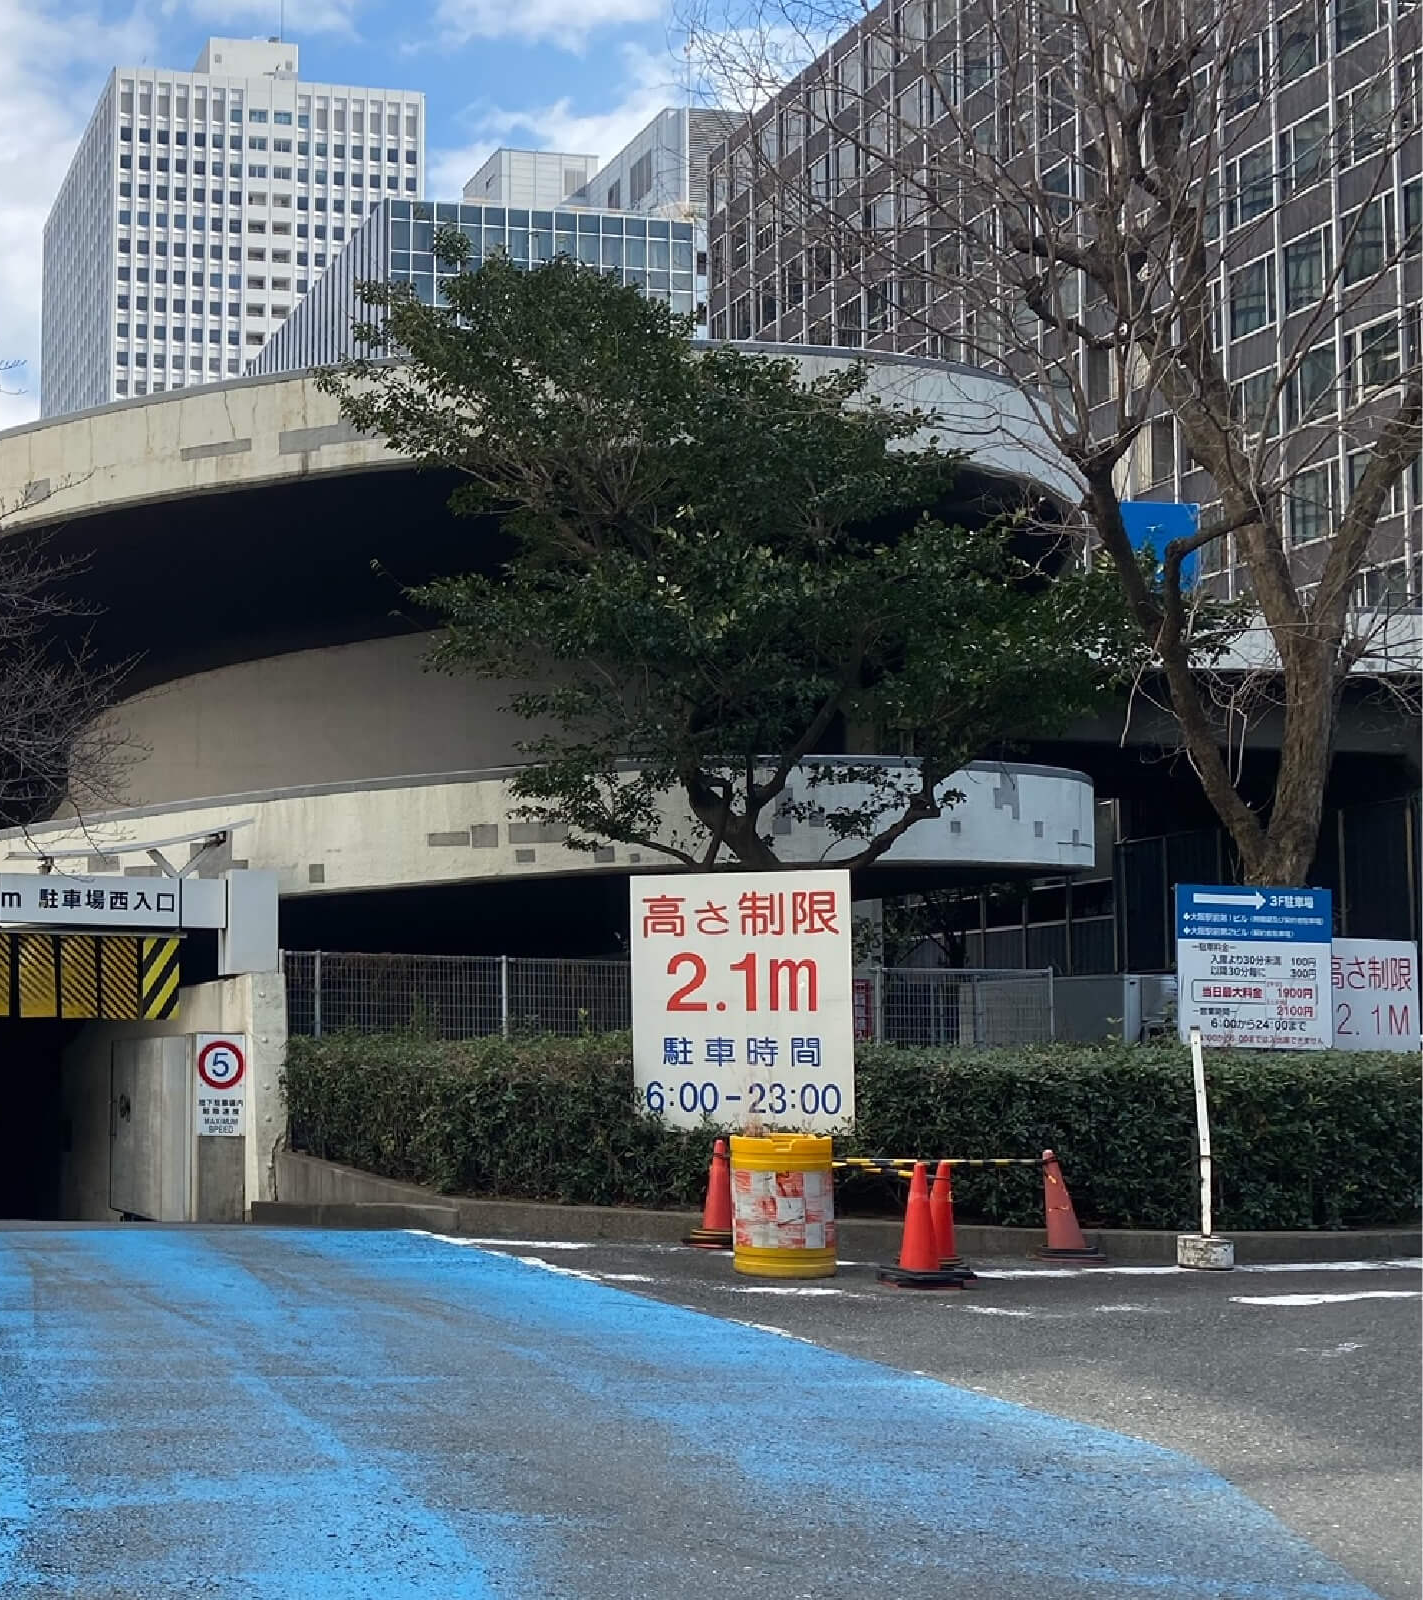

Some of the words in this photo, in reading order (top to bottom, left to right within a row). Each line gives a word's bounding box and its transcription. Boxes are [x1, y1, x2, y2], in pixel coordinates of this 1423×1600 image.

[39, 888, 175, 913] 駐車場西入口
[642, 891, 839, 938] 高さ制限
[666, 952, 818, 1011] 2.1m
[1331, 955, 1412, 991] 高さ制限
[212, 1053, 229, 1077] 5
[663, 1037, 822, 1067] 駐車時間
